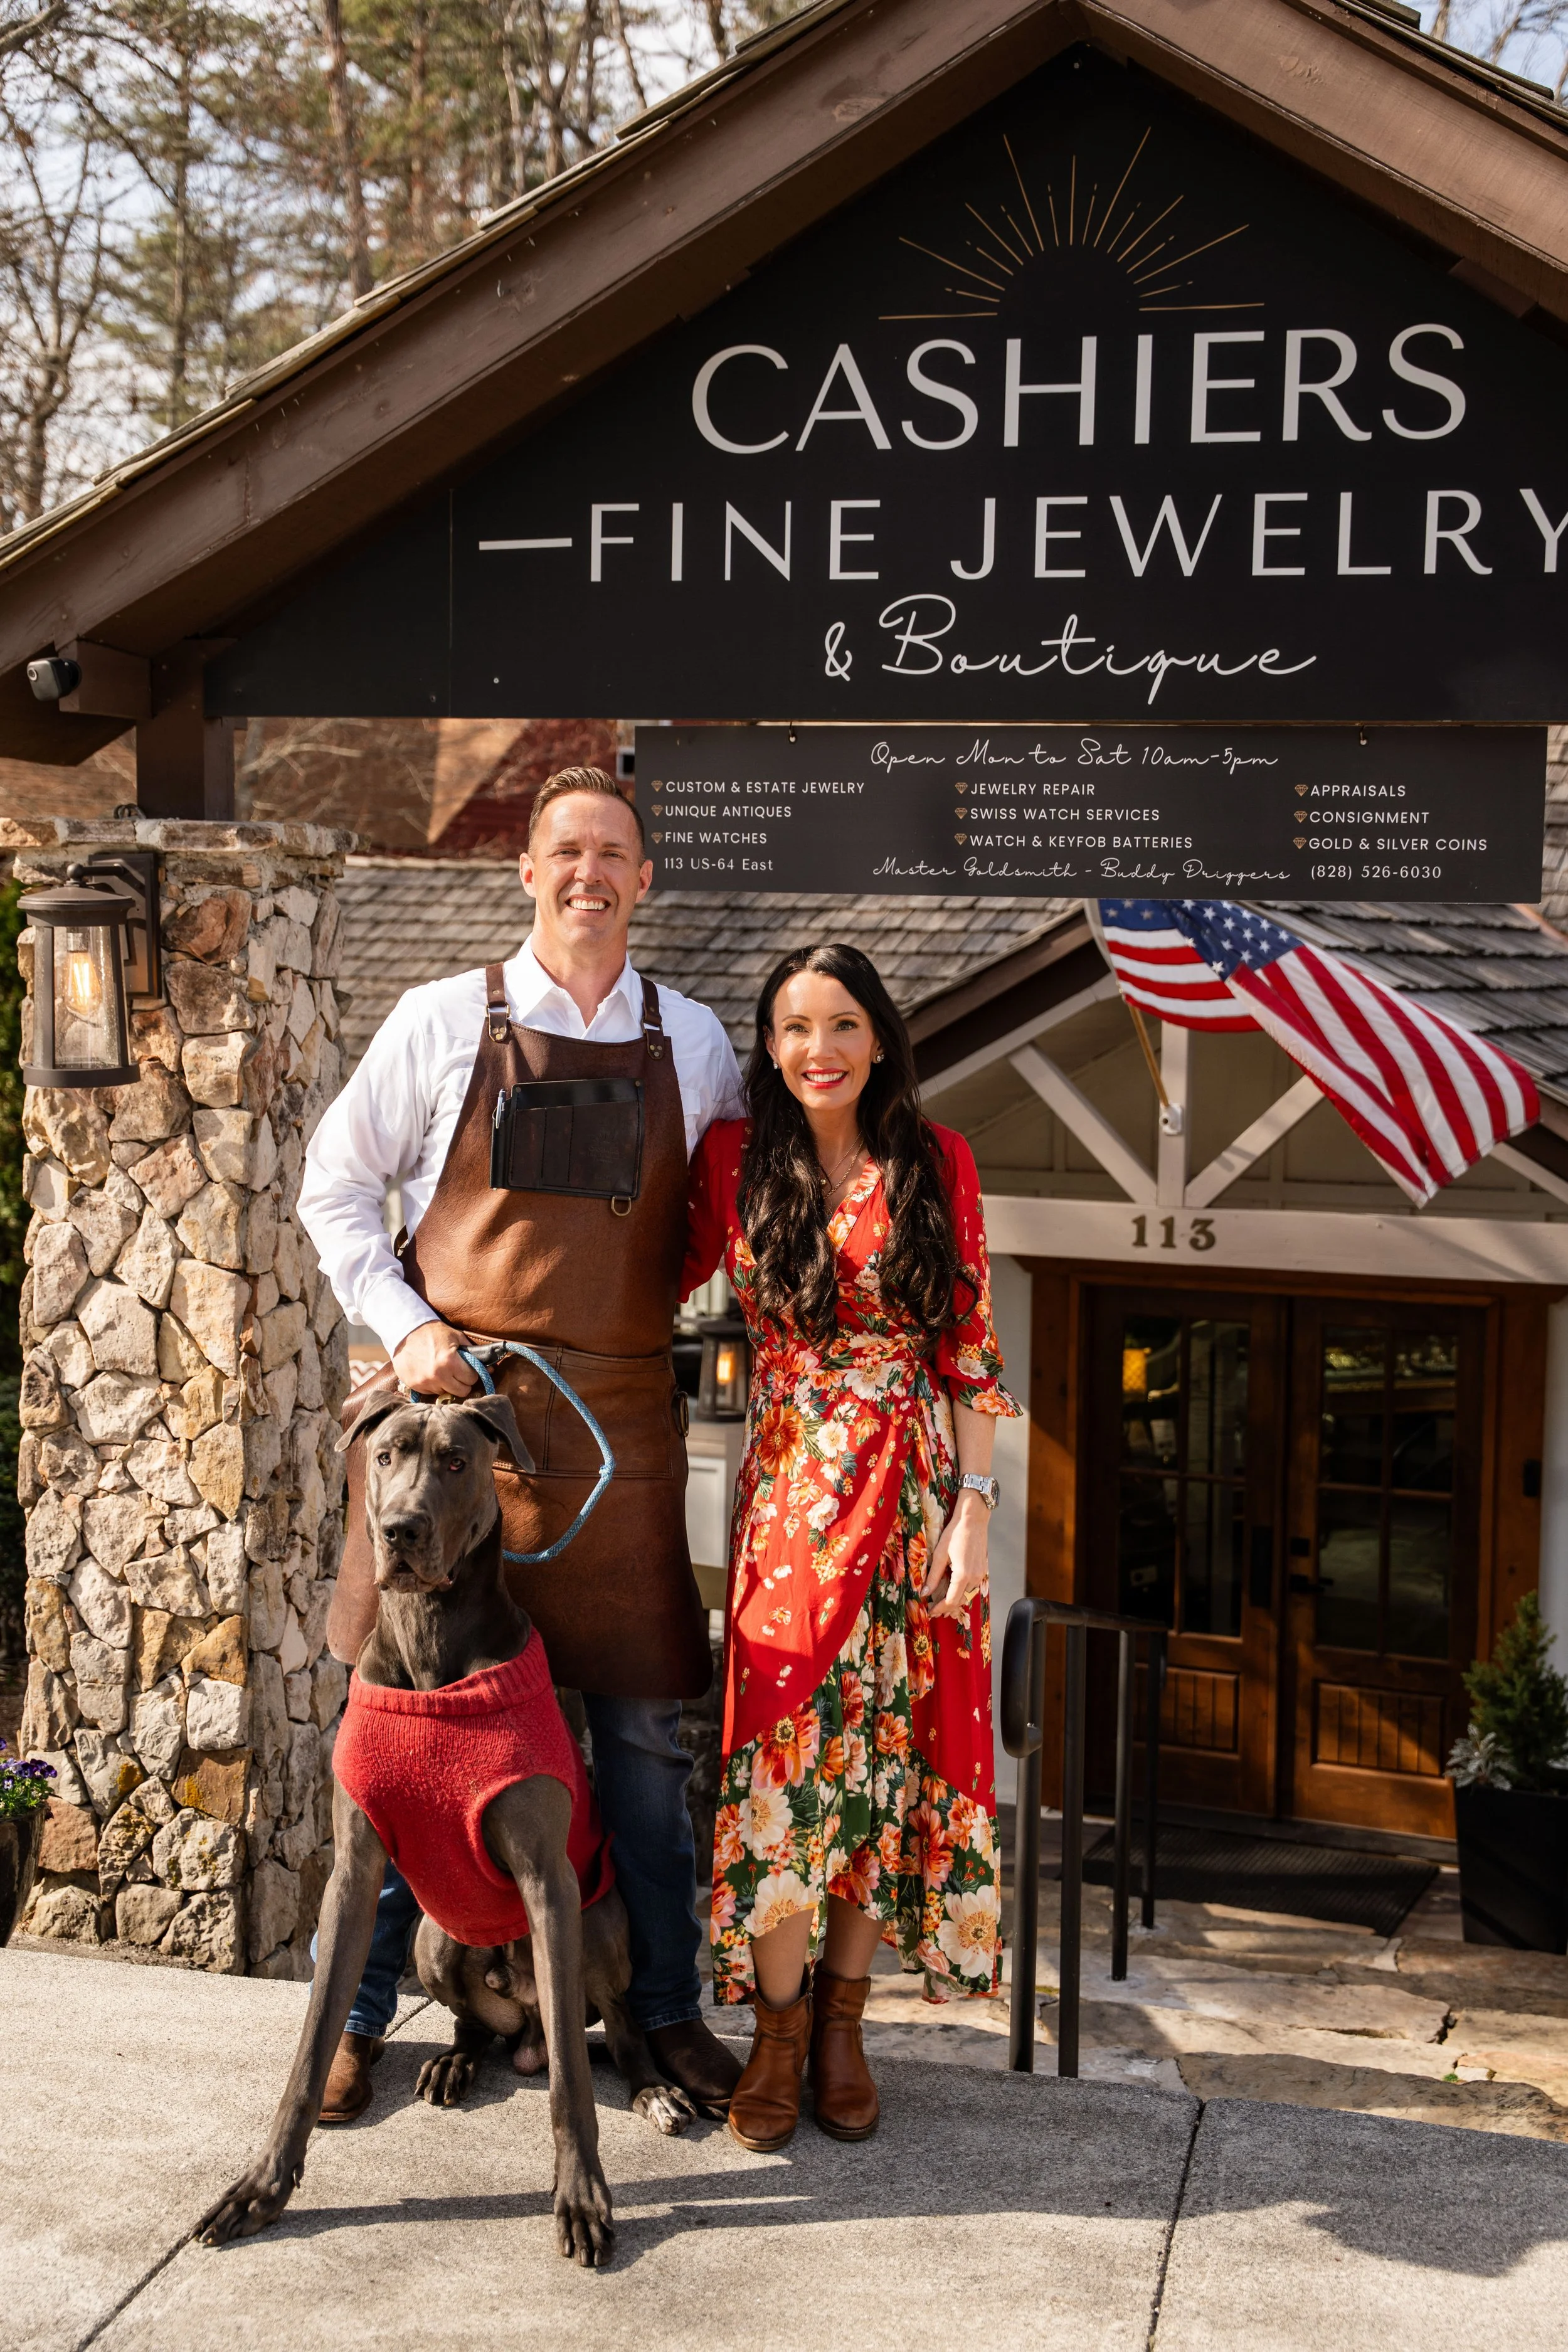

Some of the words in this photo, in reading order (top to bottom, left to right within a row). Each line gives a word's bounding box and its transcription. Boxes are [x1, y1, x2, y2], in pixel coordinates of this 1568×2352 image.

[692, 323, 1466, 454] CASHIERS
[590, 499, 881, 582] FINE
[950, 489, 1568, 580] JEWELRY
[824, 622, 852, 682] &
[879, 593, 1316, 705] Boutique
[871, 741, 945, 773] Open
[956, 739, 1025, 765] Mon
[1028, 743, 1066, 765] to
[1078, 738, 1131, 765] Sat
[1142, 746, 1278, 775] 10am-5pm
[665, 781, 725, 793] CUSTOM
[731, 781, 740, 793] &
[746, 781, 796, 793] ESTATE
[802, 782, 864, 793] JEWELRY
[970, 783, 1036, 795] JEWELRY
[1043, 783, 1094, 795] REPAIR
[1310, 785, 1406, 797] APPRAISALS
[665, 805, 716, 818] UNIQUE
[722, 805, 792, 819] ANTIQUES
[970, 808, 1017, 820] SWISS
[1023, 808, 1079, 820] WATCH
[1086, 808, 1159, 821] SERVICES
[1310, 811, 1429, 824] CONSIGNMENT
[665, 832, 693, 843] FINE
[699, 832, 767, 844] WATCHES
[970, 835, 1025, 847] WATCH
[1032, 835, 1042, 847] &
[1049, 835, 1106, 847] KEYFOB
[1113, 836, 1192, 849] BATTERIES
[1309, 837, 1352, 849] GOLD
[1359, 838, 1370, 850] &
[1377, 838, 1429, 850] SILVER
[1436, 839, 1486, 850] COINS
[665, 857, 683, 869] 113
[691, 857, 734, 870] US-64
[742, 858, 773, 871] East
[872, 857, 956, 876] Master
[963, 856, 1077, 877] Goldsmith
[1100, 857, 1175, 885] Buddy
[1182, 859, 1290, 886] Driggers
[1311, 865, 1352, 881] (828)
[1361, 866, 1441, 879] 526-6030
[1131, 1214, 1216, 1252] 113
